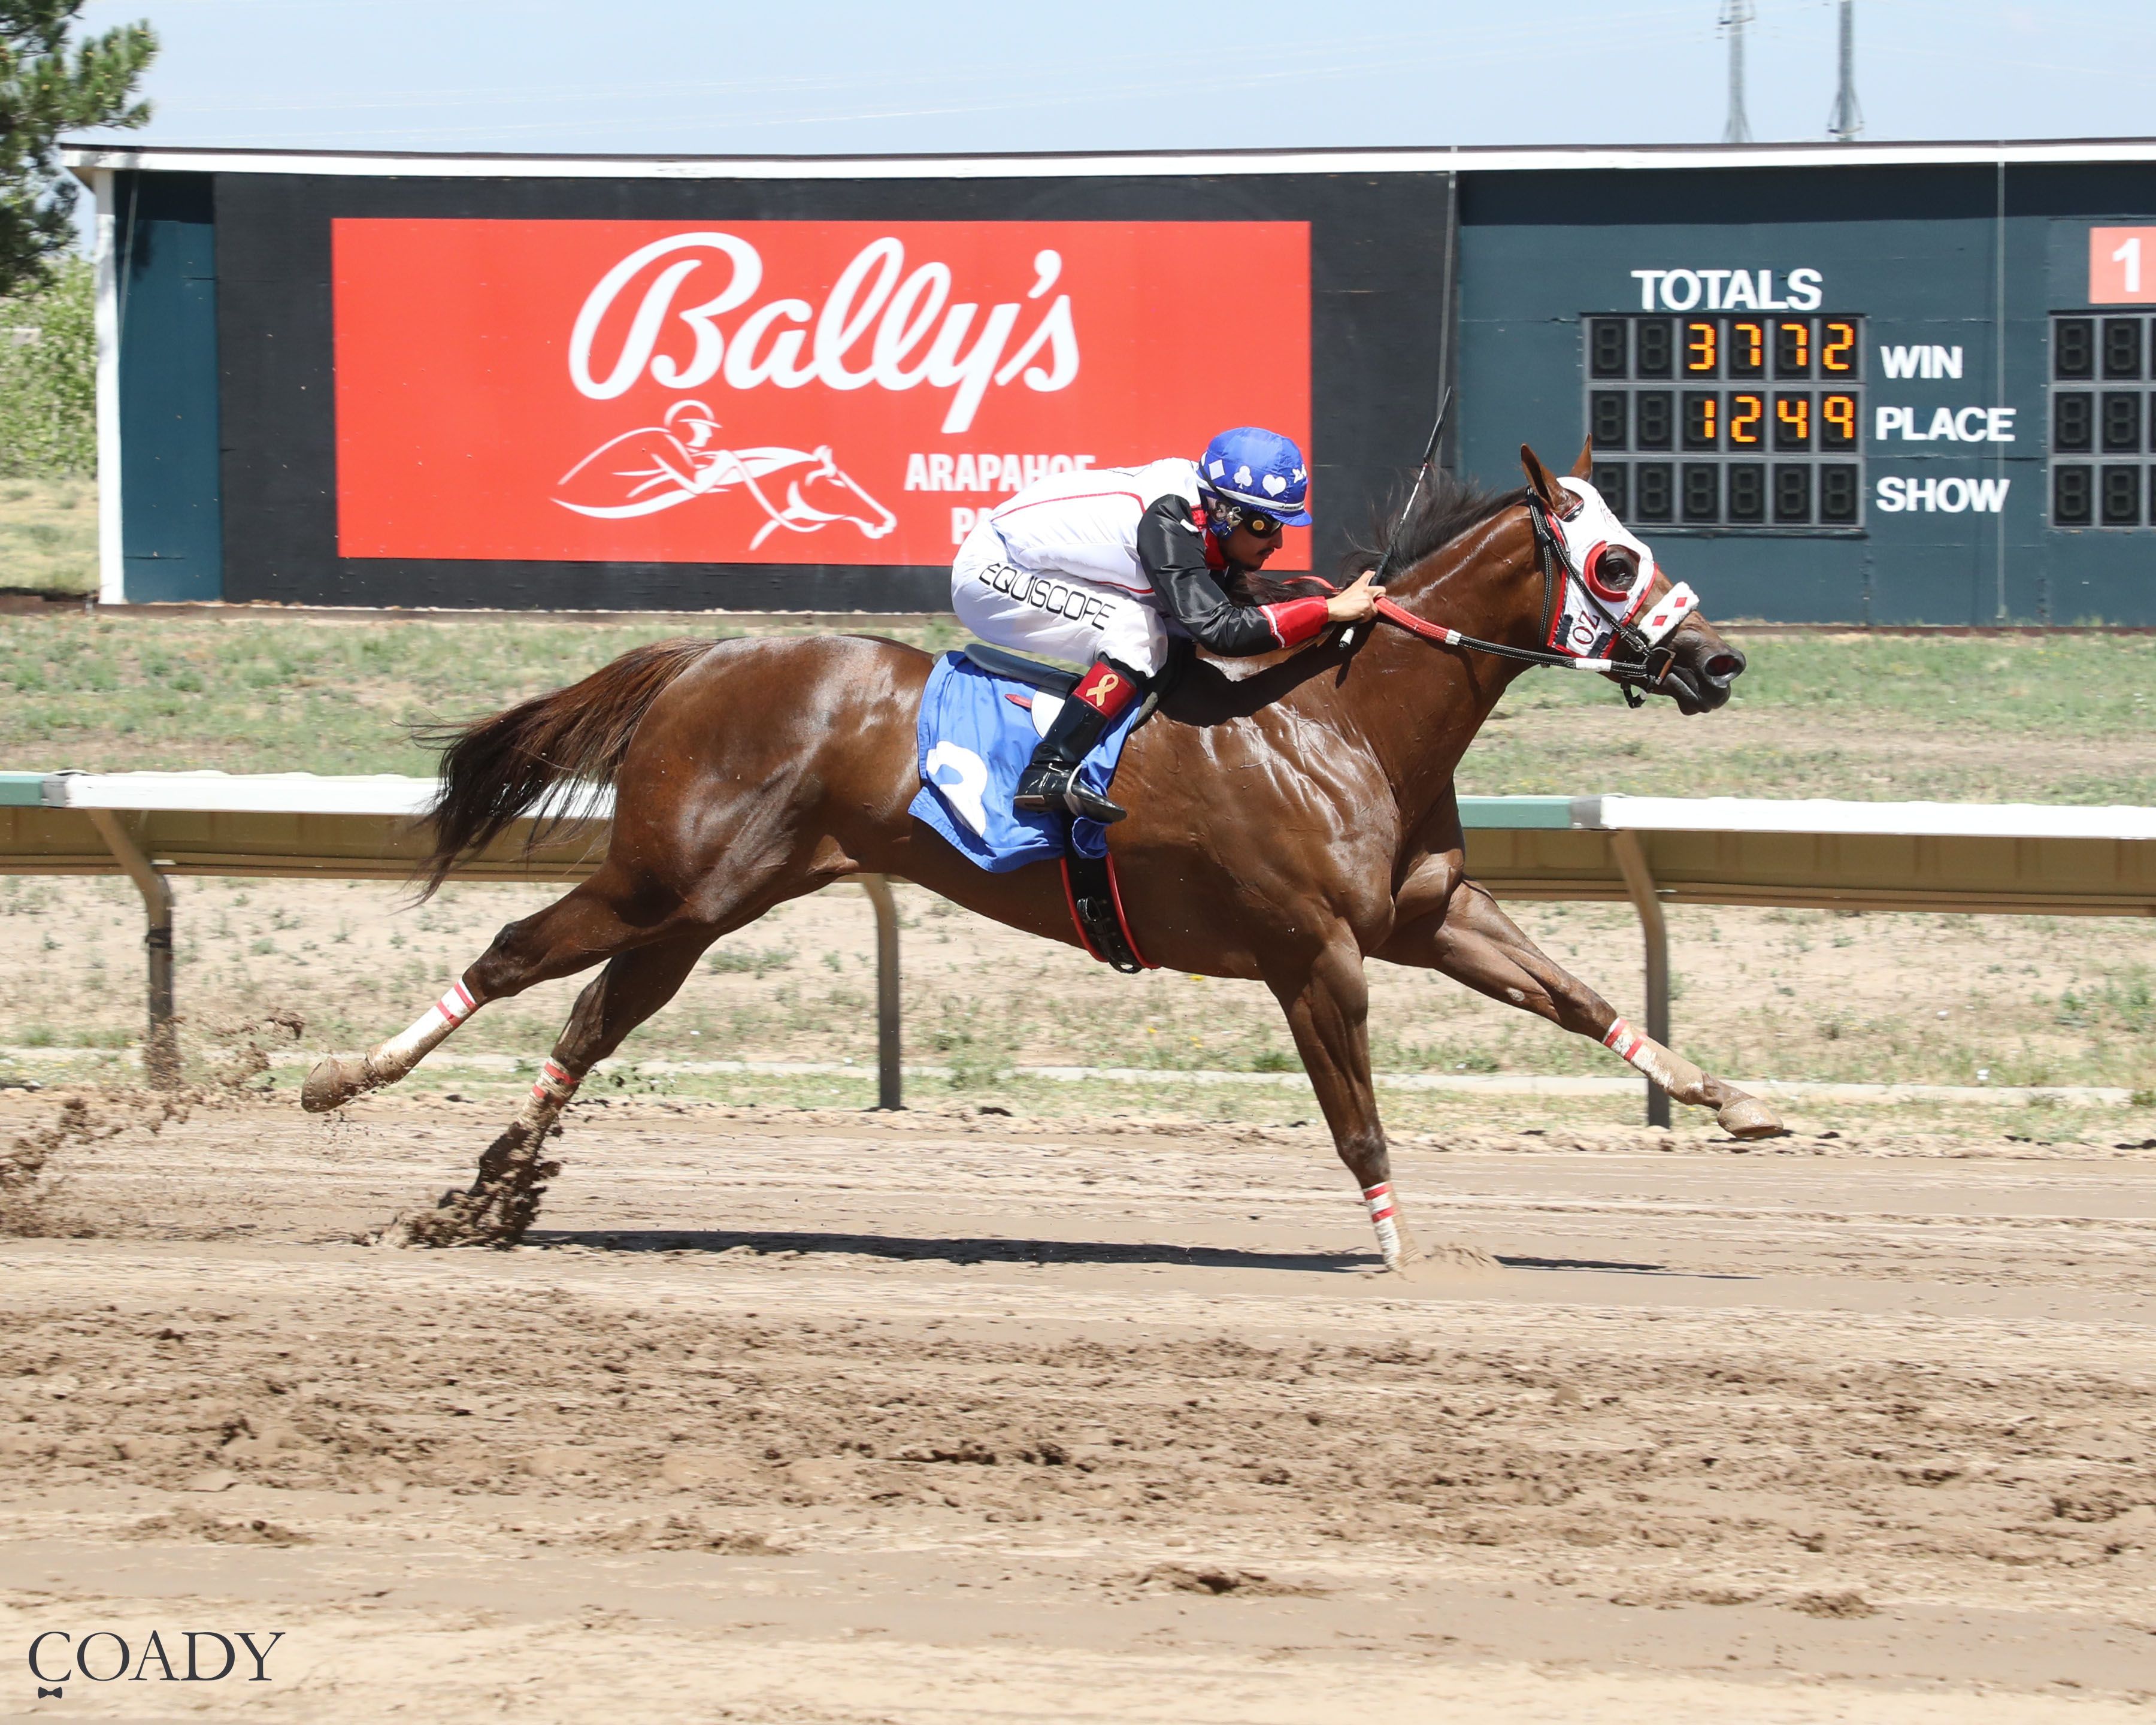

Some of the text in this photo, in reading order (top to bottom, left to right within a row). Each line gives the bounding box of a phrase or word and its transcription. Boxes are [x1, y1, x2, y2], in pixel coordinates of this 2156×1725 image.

[2111, 237, 2142, 293] 1
[1631, 268, 1823, 311] TOTALS
[569, 232, 1079, 434] Bally's
[1689, 323, 1854, 370] 3772
[1880, 345, 1963, 379] WIN
[1704, 396, 1854, 443] 1249
[1876, 407, 2016, 442] PLACE
[1876, 477, 2010, 513] SHOW
[979, 563, 1116, 631] EQUISCOPE
